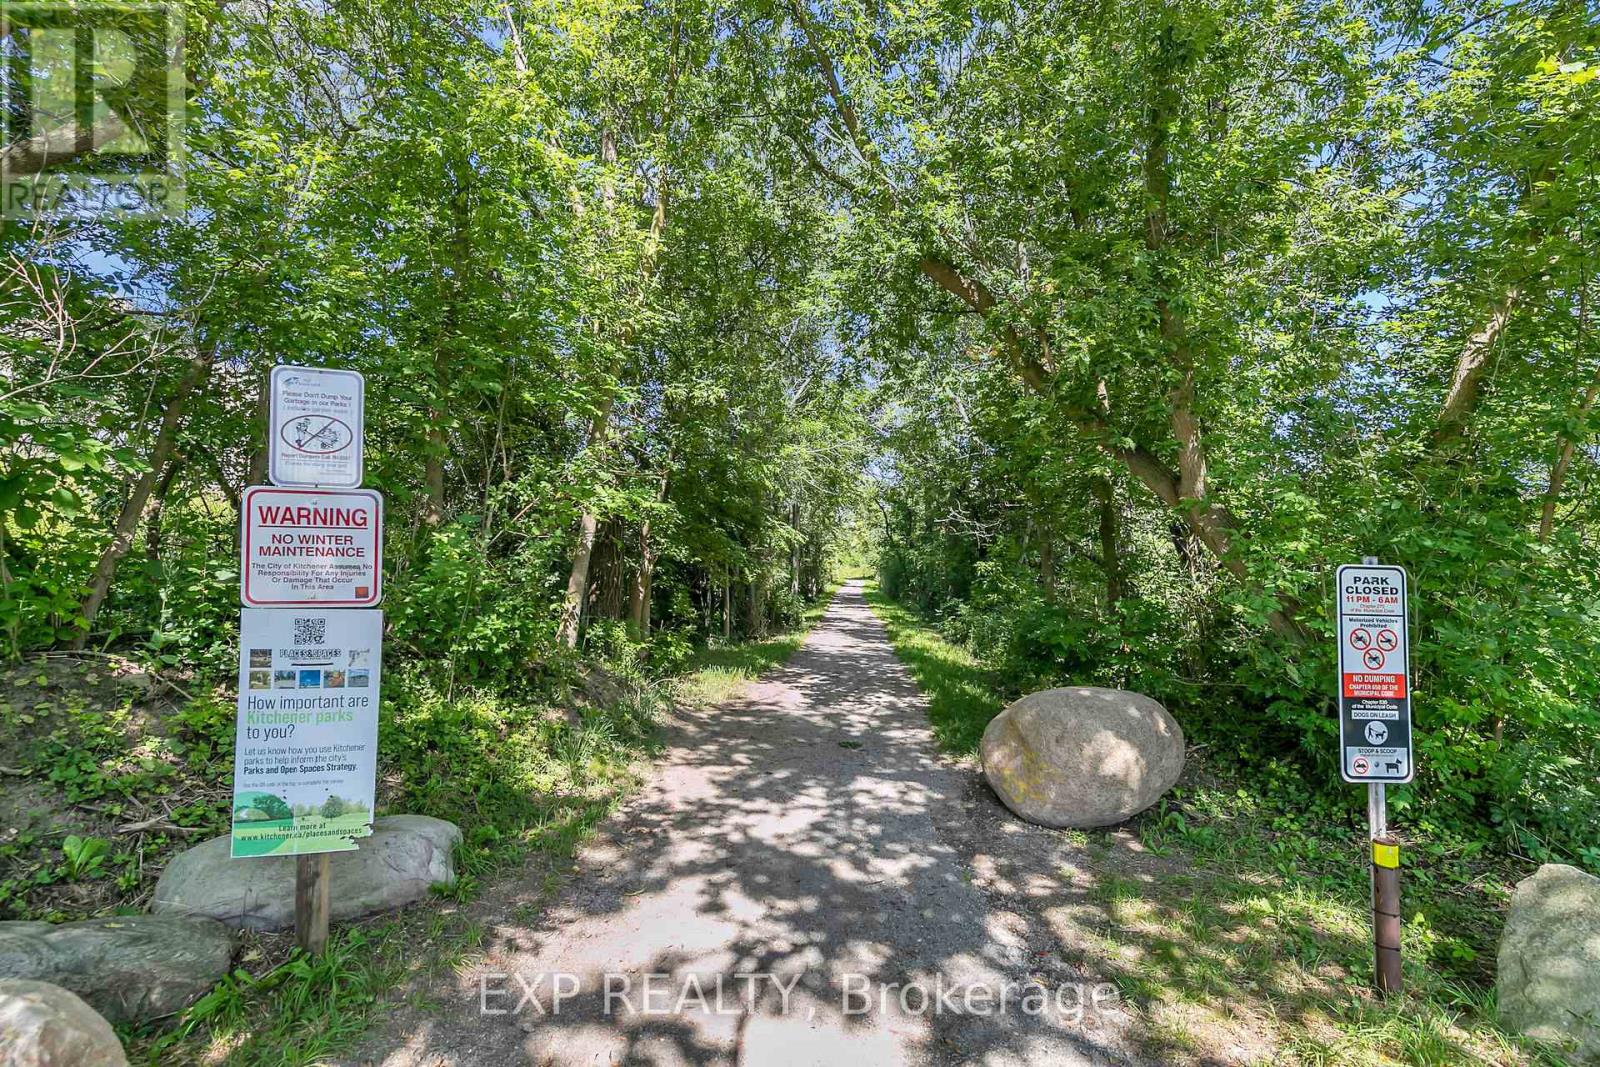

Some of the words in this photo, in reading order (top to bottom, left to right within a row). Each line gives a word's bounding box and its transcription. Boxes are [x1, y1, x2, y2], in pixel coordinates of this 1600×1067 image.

[284, 398, 310, 406] Garbage
[321, 393, 338, 401] Dump
[258, 506, 367, 526] WARNING
[271, 534, 293, 544] NO
[298, 535, 353, 545] WINTER
[259, 546, 366, 557] MAINTENANCE
[1353, 577, 1390, 585] PARK
[1346, 586, 1398, 595] CLOSED
[1364, 675, 1395, 683] DUMPING
[248, 696, 276, 710] How
[280, 695, 345, 711] important
[348, 696, 369, 708] are
[247, 711, 313, 725] Kitchener
[316, 710, 353, 724] parks
[247, 726, 260, 739] to
[264, 724, 295, 741] you?
[244, 747, 256, 756] Let
[268, 747, 286, 755] know
[288, 746, 302, 754] how
[305, 747, 317, 755] you
[333, 744, 366, 752] Kitchener
[244, 758, 264, 766] parks
[275, 756, 289, 765] help
[290, 756, 313, 764] inform
[315, 755, 327, 763] the
[243, 767, 264, 775] Parks
[266, 766, 279, 774] and
[280, 765, 297, 775] Open
[300, 764, 324, 773] Spaces
[241, 828, 362, 840] www.kitchener.ca/placesandspaces
